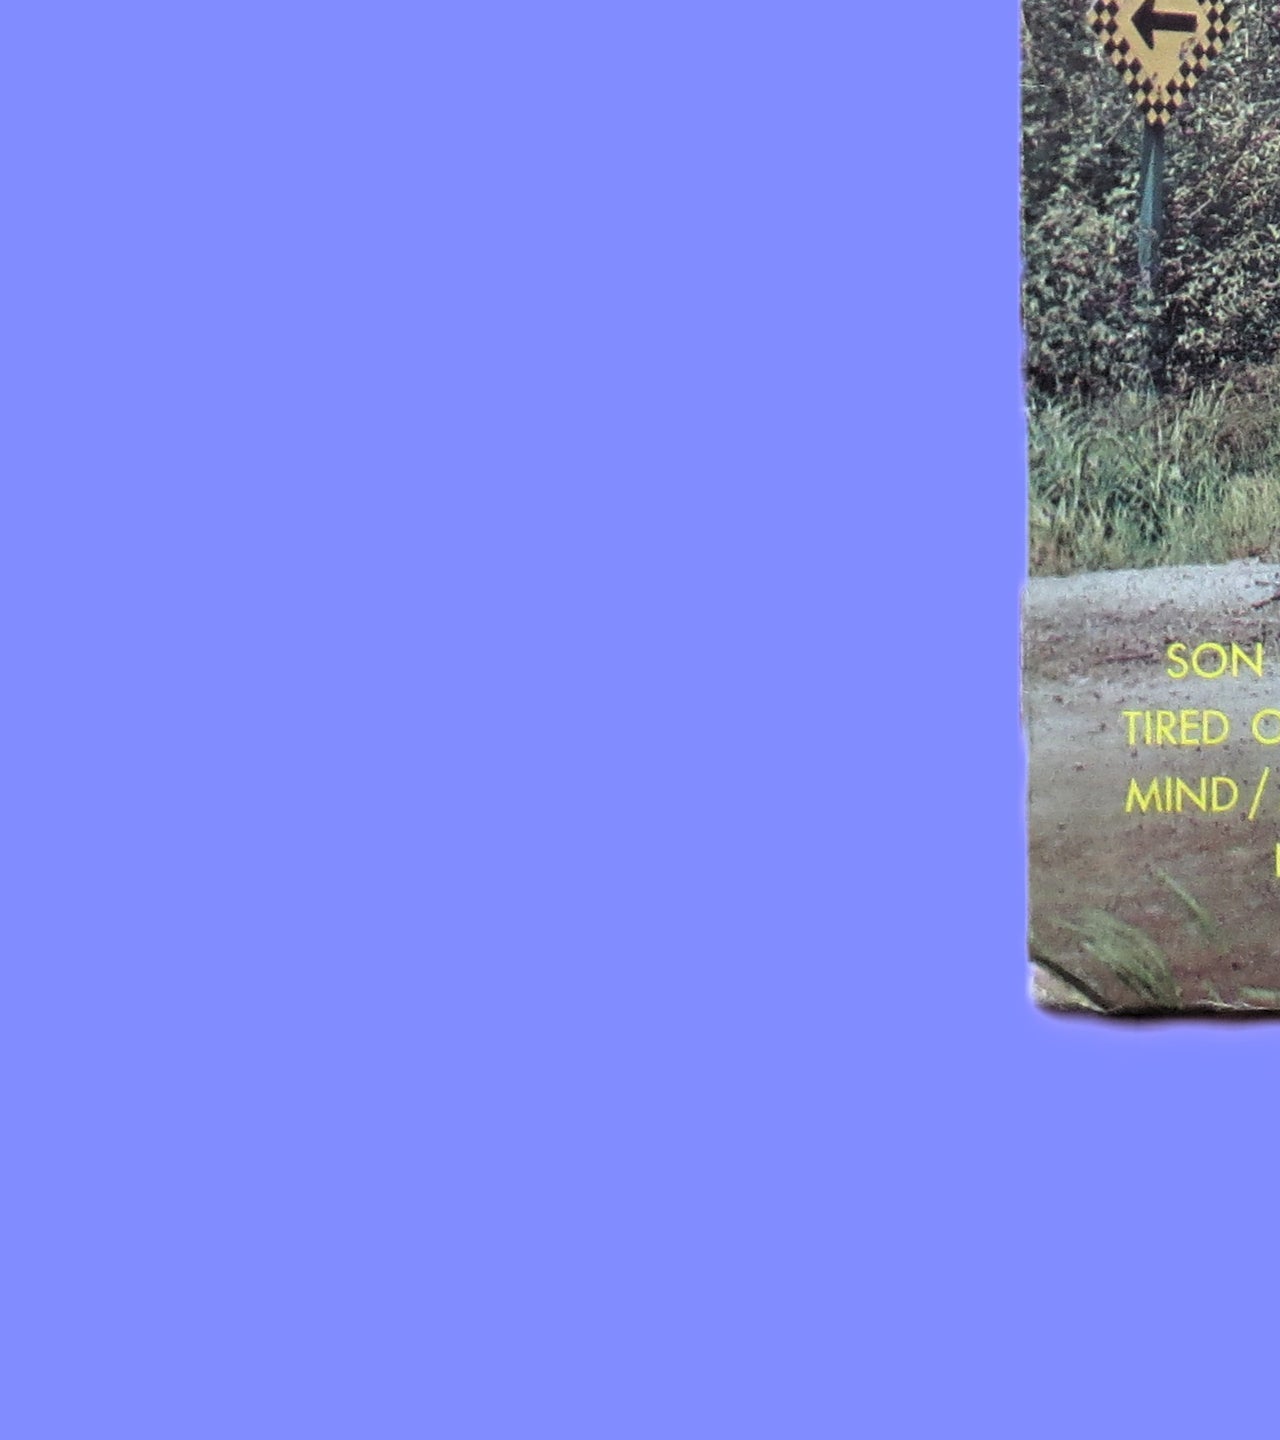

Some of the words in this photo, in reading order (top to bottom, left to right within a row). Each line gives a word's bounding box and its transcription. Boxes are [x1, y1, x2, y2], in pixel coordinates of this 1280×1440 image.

[1167, 642, 1264, 680] SON
[1123, 709, 1230, 745] TIRED
[1125, 775, 1238, 812] MIND
